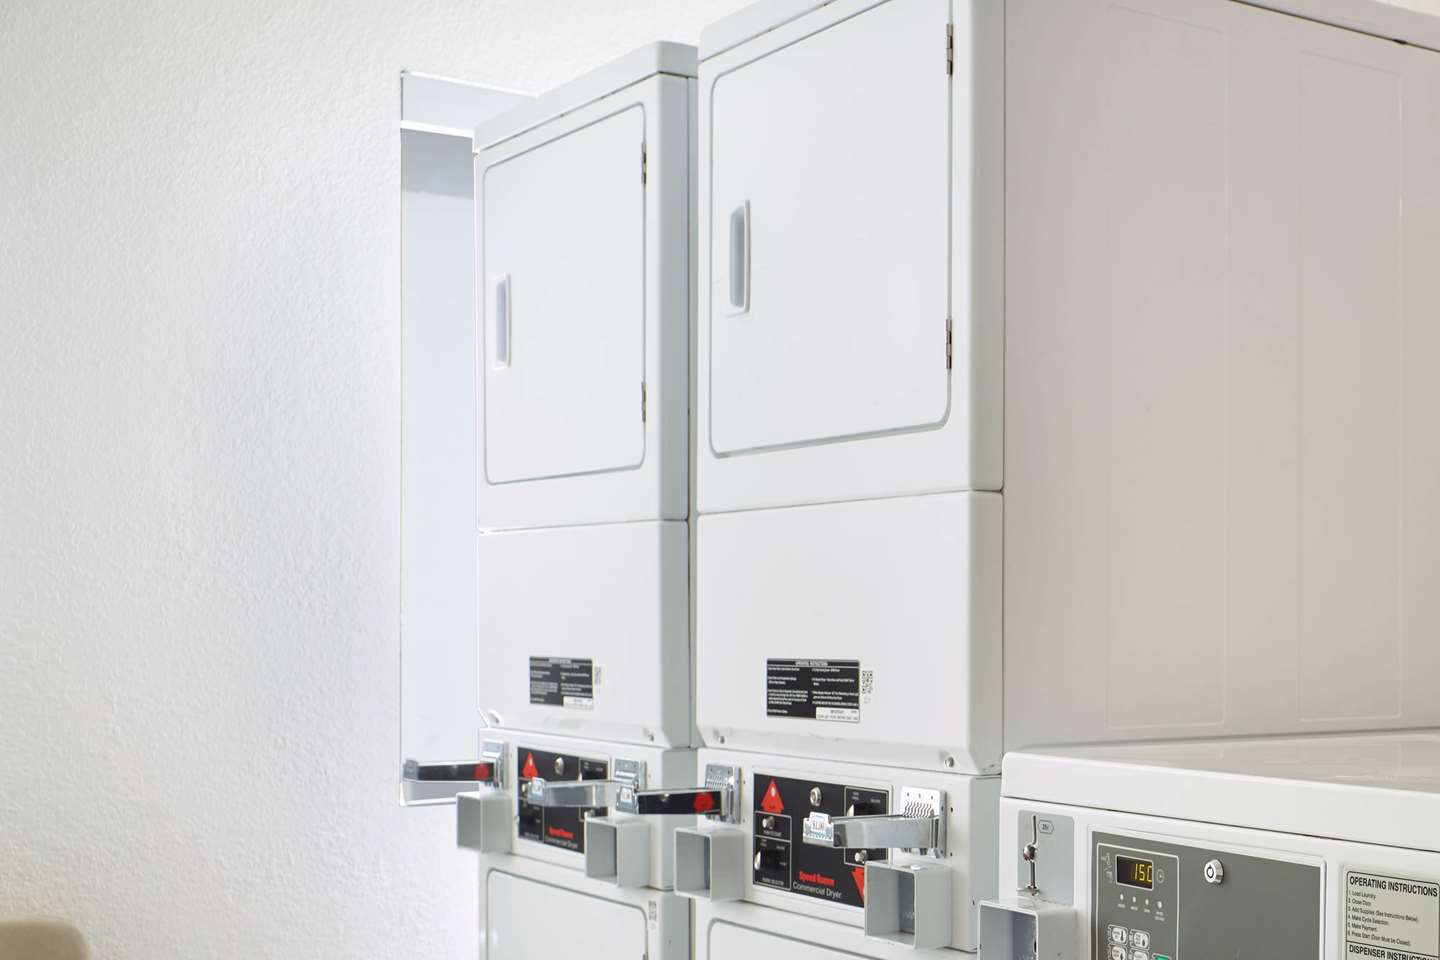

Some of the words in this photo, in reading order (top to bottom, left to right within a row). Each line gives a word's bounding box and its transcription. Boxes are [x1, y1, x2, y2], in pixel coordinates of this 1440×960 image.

[793, 881, 825, 894] Commercial
[826, 887, 842, 899] Dryer
[1349, 876, 1387, 890] OPERATING
[1387, 881, 1438, 897] INSTRUCTIONS
[1349, 944, 1386, 959] DISPENSER
